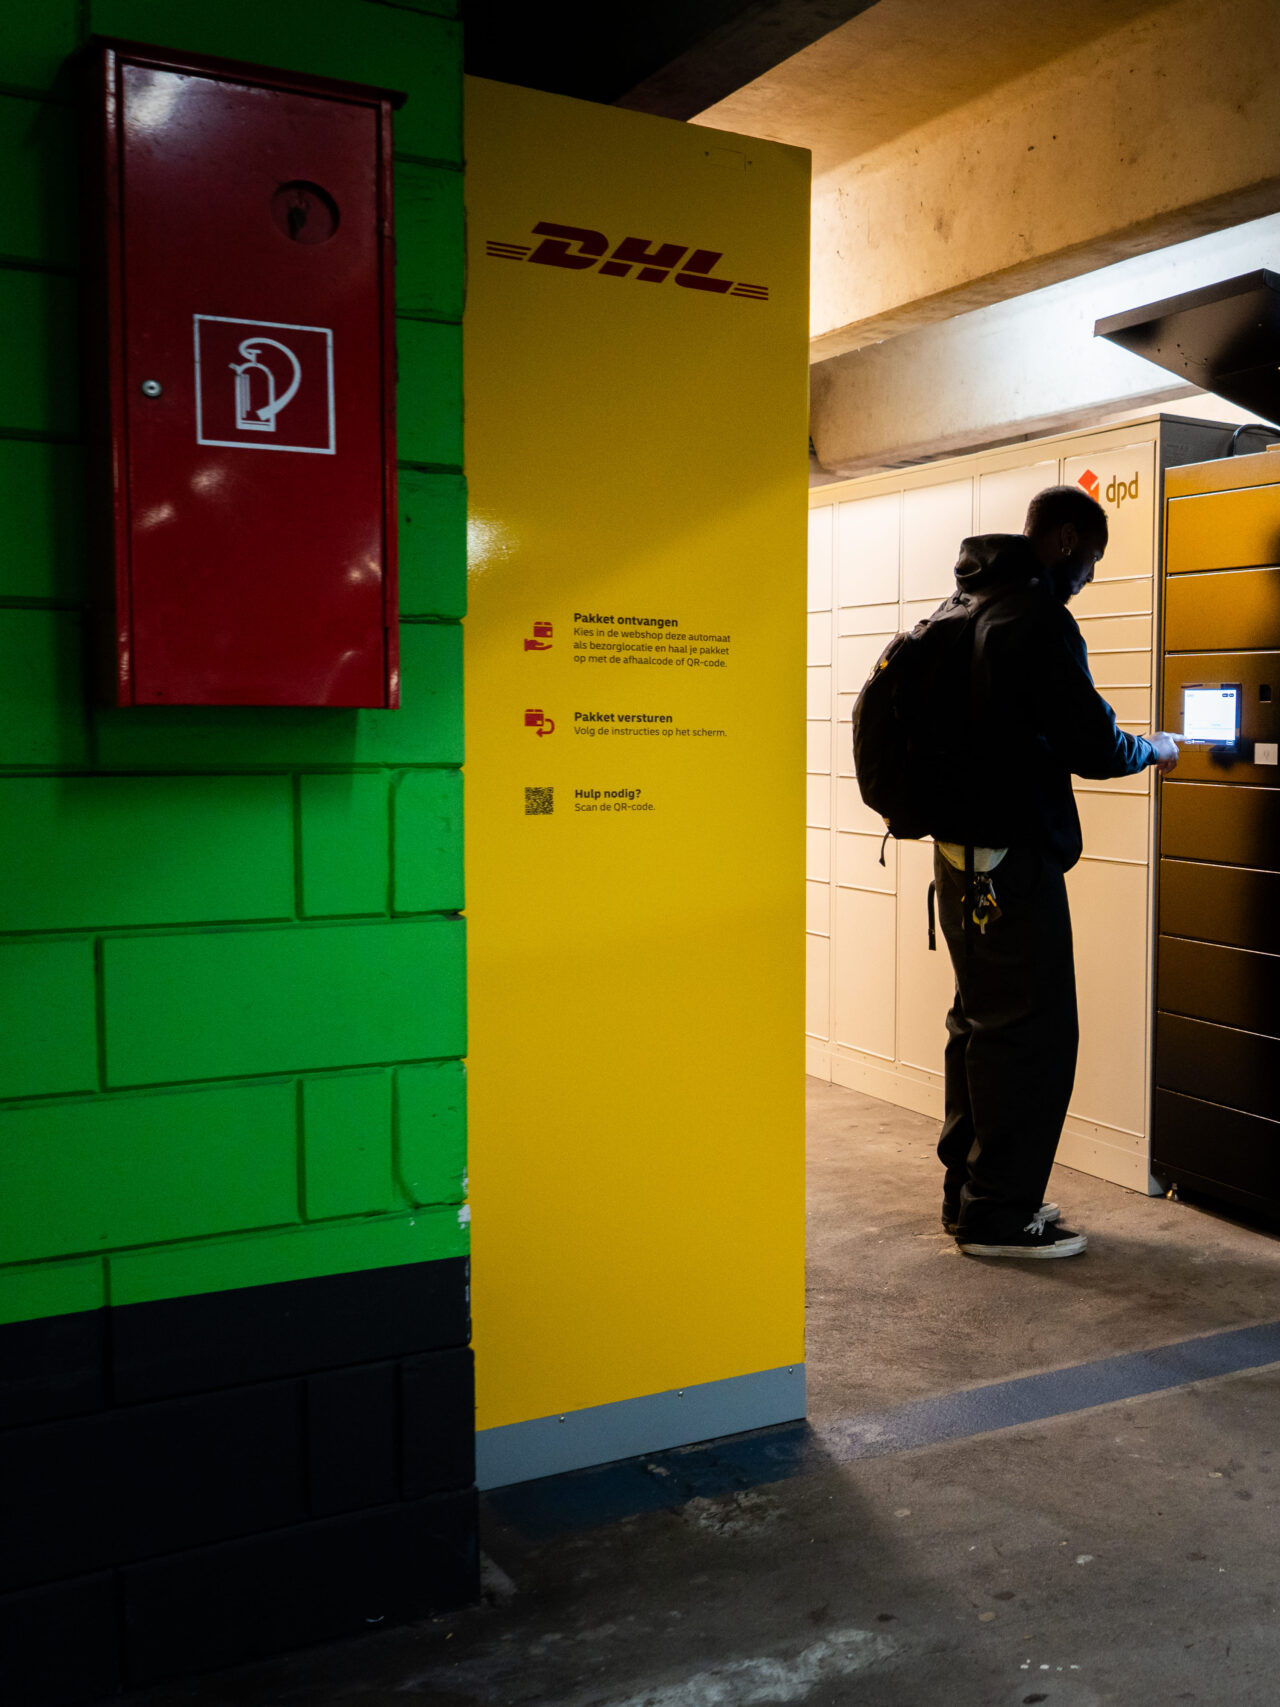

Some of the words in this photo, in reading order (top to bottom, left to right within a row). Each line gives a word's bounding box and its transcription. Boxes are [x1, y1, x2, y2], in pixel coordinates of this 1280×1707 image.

[527, 221, 734, 294] DHL
[1106, 471, 1139, 509] dpd
[574, 613, 614, 624] Pakket
[617, 616, 678, 629] ontvangen
[574, 628, 593, 636] Kies
[596, 628, 604, 636] in
[608, 629, 619, 637] de
[621, 630, 663, 641] webshop
[666, 632, 685, 640] deze
[688, 634, 730, 642] automaat
[574, 641, 587, 649] als
[590, 641, 652, 652] bezorglocatie
[668, 645, 687, 653] haal
[690, 645, 697, 655] je
[700, 646, 729, 655] pakket
[574, 655, 585, 665] op
[588, 655, 606, 663] met
[609, 655, 621, 664] de
[623, 655, 673, 665] afhaalcode
[676, 658, 684, 666] of
[687, 658, 727, 667] QR-code.
[574, 712, 614, 722] Pakket
[617, 714, 673, 723] versturen
[574, 726, 595, 737] Volg
[598, 727, 609, 735] de
[612, 727, 659, 735] instructies
[662, 729, 673, 737] op
[676, 728, 690, 736] het
[693, 728, 727, 736] scherm.
[575, 789, 601, 800] Hulp
[604, 789, 641, 800] nodig?
[575, 803, 597, 811] Scan
[600, 803, 611, 811] de
[614, 803, 655, 812] QR-code.
